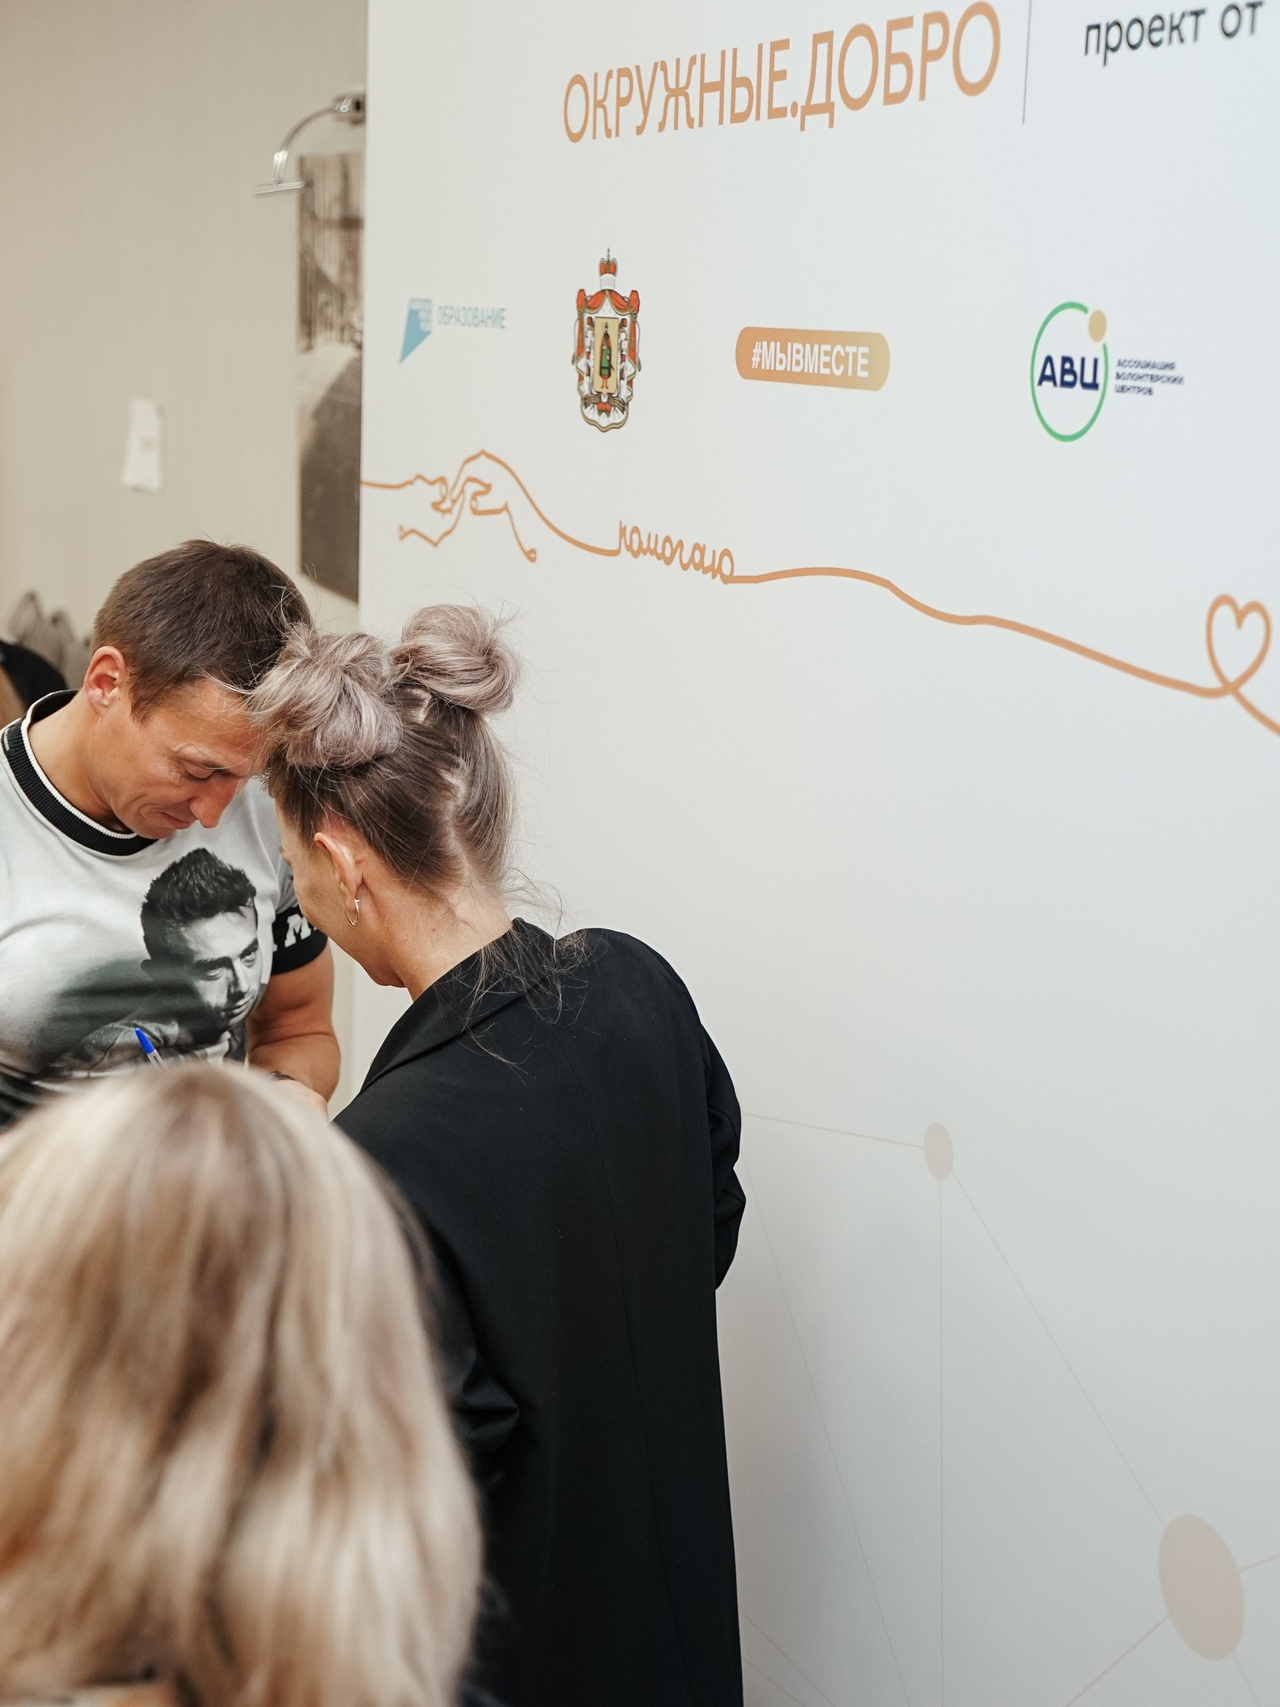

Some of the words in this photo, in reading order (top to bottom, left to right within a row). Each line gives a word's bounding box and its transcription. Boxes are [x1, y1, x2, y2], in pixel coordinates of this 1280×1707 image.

[1084, 8, 1207, 67] проект
[1221, 1, 1265, 38] от
[564, 1, 1001, 143] ОКРУЖНЫЕ.ДОБРО
[437, 305, 506, 329] ОБРАЗОВАНИЕ
[751, 341, 870, 378] #МЫВМЕСТЕ
[1037, 354, 1100, 391] АВЦ
